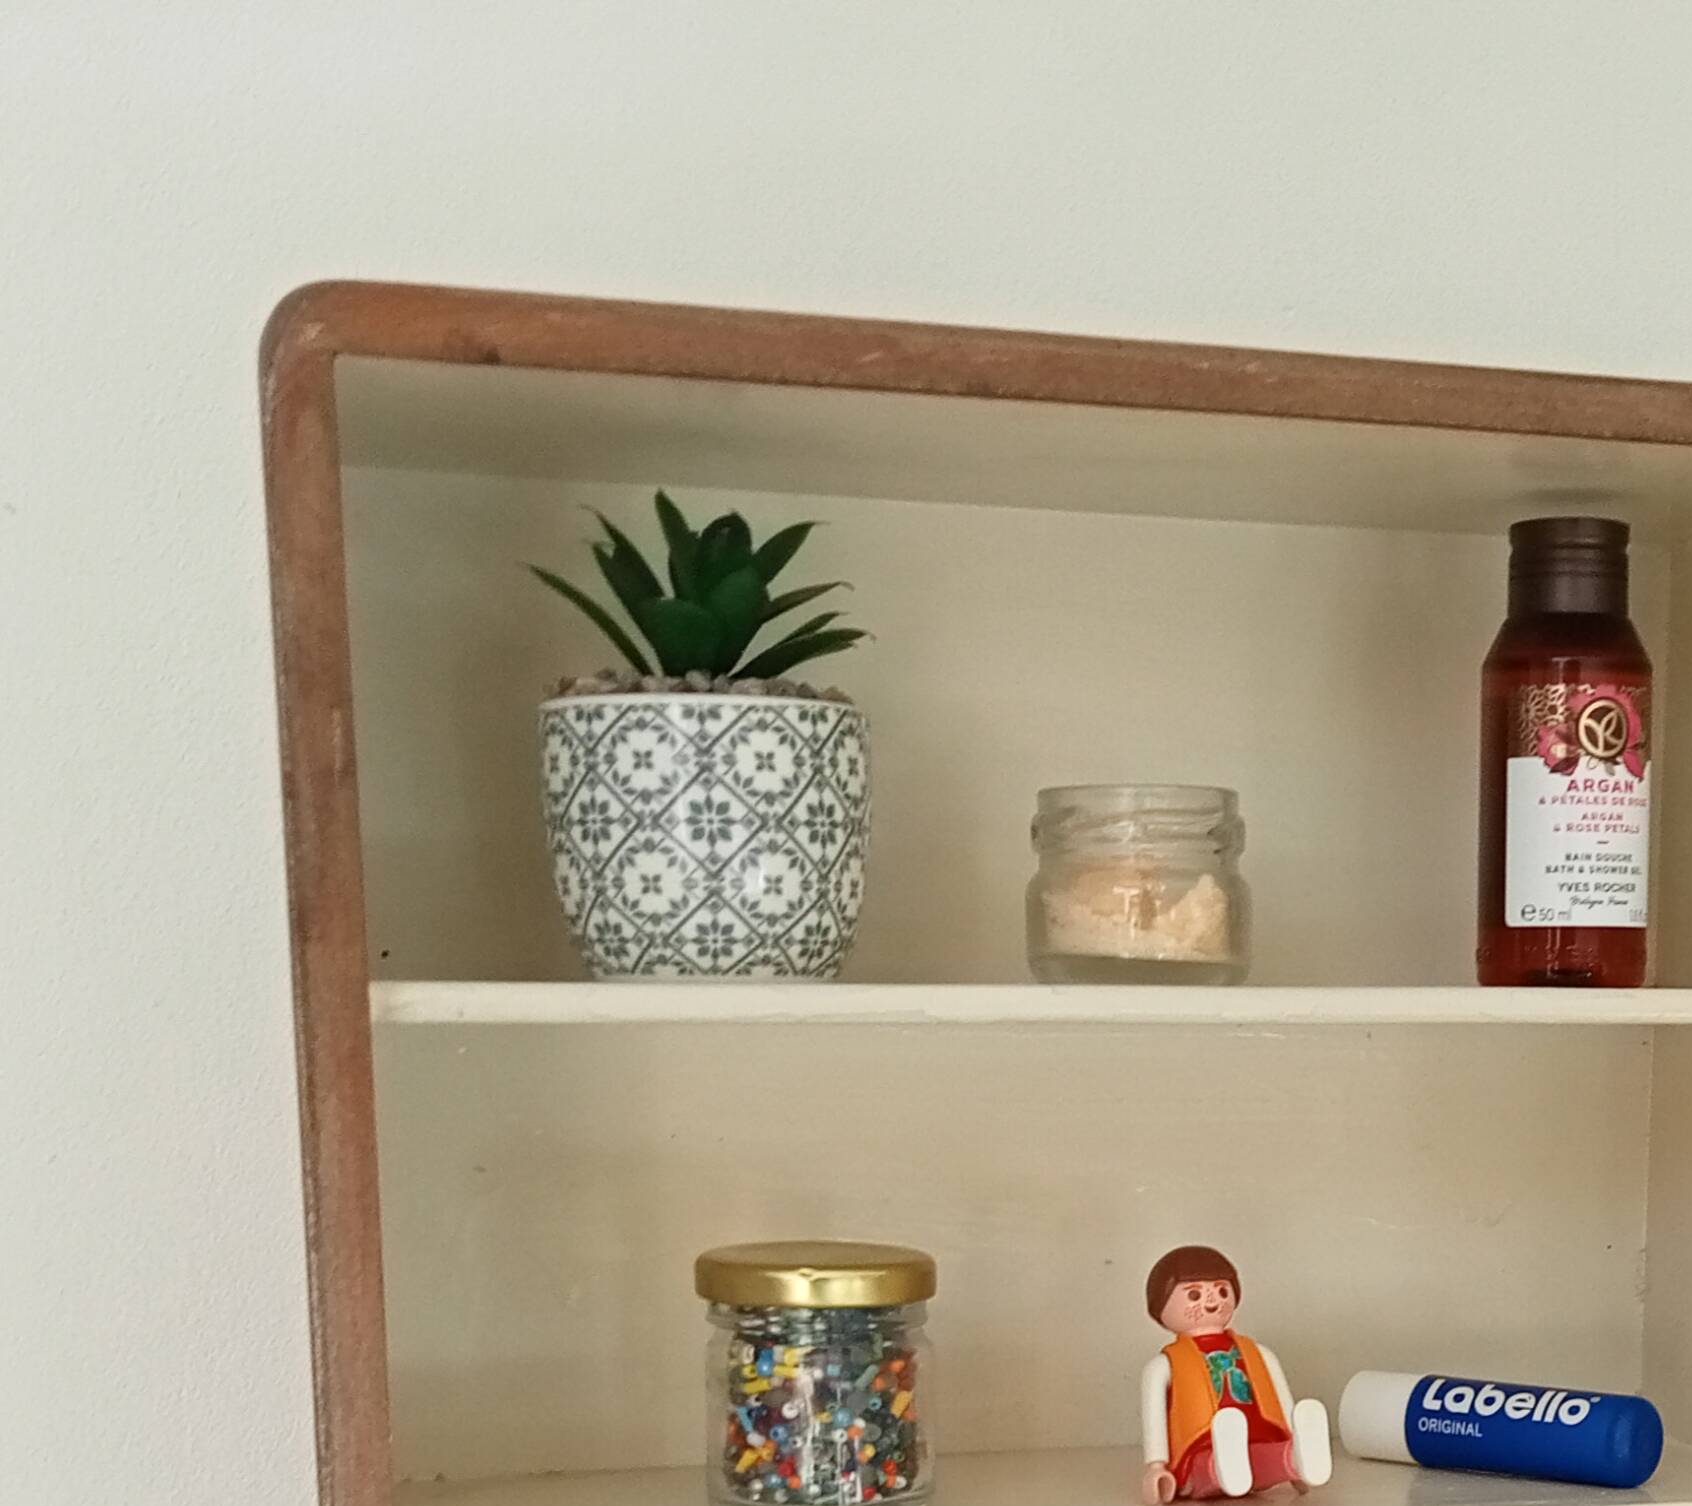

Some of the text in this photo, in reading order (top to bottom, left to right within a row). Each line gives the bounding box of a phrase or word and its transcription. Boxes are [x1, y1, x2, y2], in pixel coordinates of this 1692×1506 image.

[1566, 779, 1634, 793] ARGAN
[1581, 812, 1623, 821] ARGAN
[1566, 823, 1601, 833] ROSE
[1559, 882, 1591, 893] YVES
[1538, 907, 1555, 922] 50
[1421, 1377, 1592, 1426] Labello
[1417, 1416, 1483, 1438] ORIGINAL
